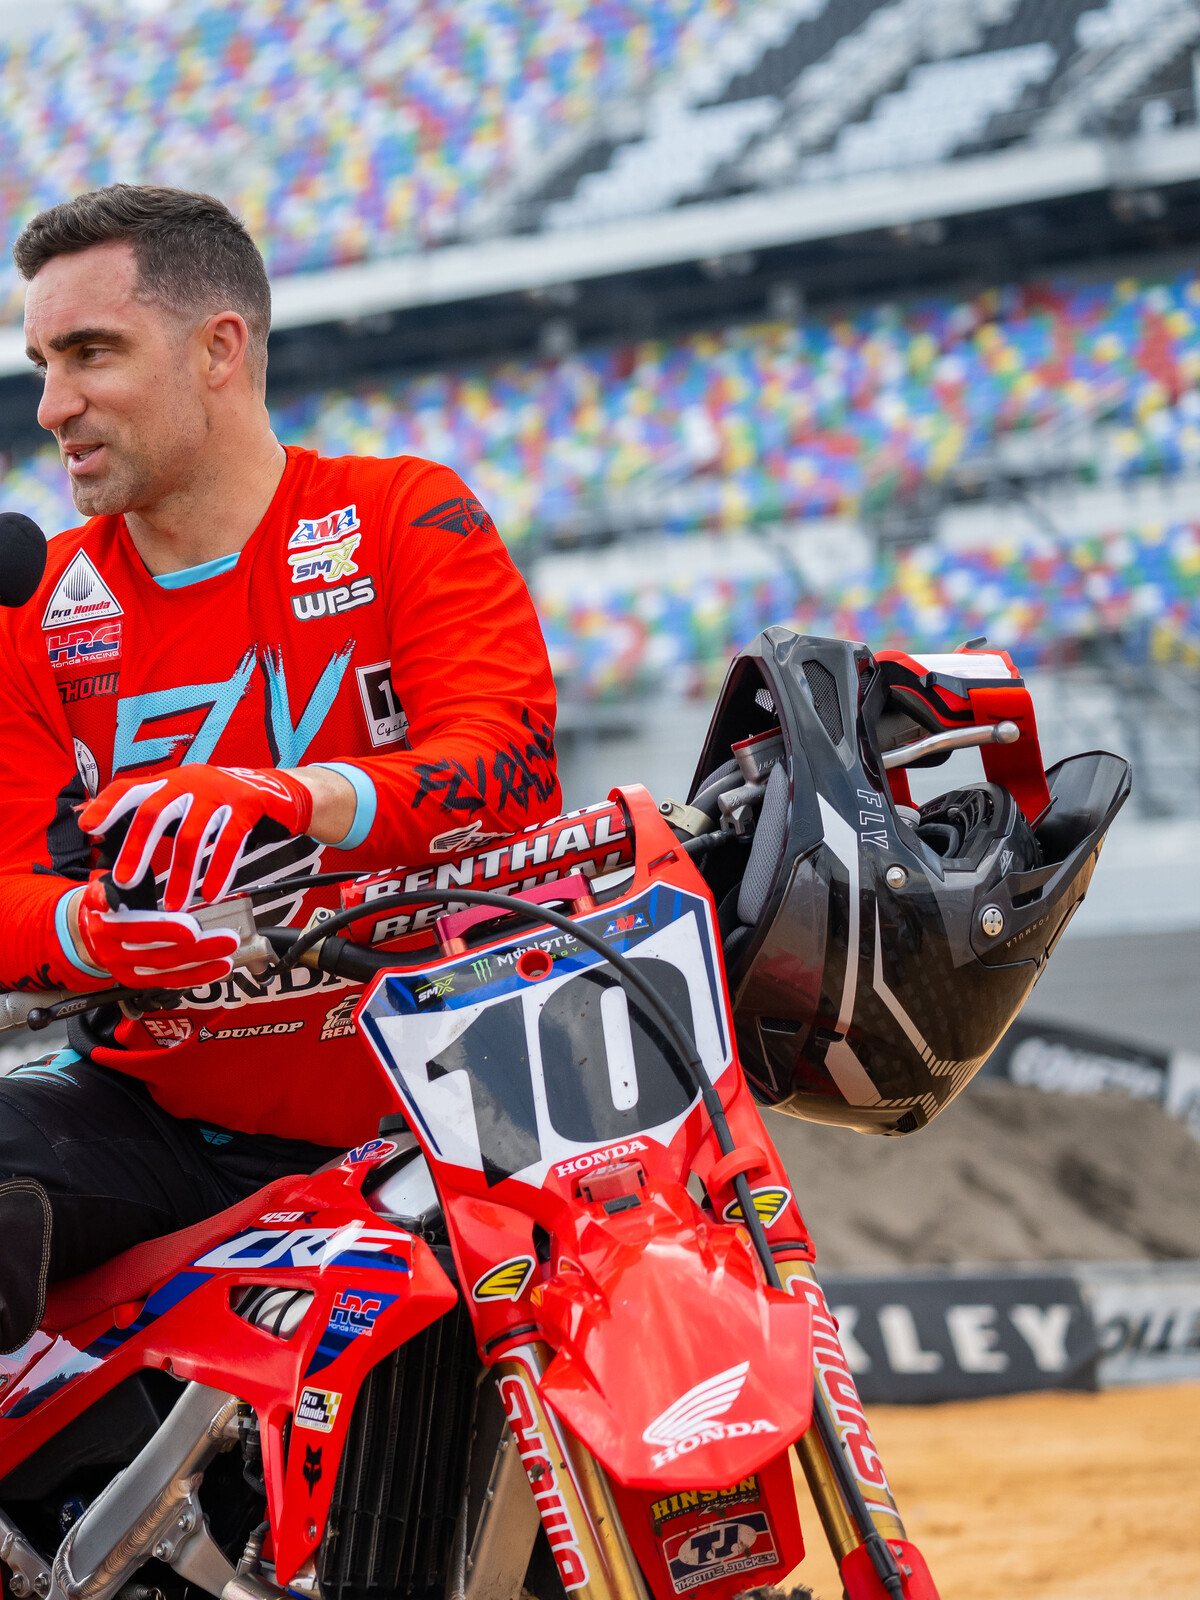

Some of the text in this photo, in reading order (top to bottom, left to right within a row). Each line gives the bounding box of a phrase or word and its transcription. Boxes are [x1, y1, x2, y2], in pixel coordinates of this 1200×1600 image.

[291, 508, 356, 543] AMA
[296, 543, 356, 579] SMX
[51, 601, 111, 620] Pro Honda
[291, 576, 376, 620] WPS
[48, 623, 121, 663] HRC
[82, 651, 119, 662] RACING
[856, 788, 889, 850] FLY
[363, 814, 628, 904] RENTHAL
[603, 912, 648, 938] AMA
[1006, 915, 1049, 948] FORMULA
[497, 932, 577, 967] MONSTE
[418, 975, 456, 1003] SMX
[214, 1022, 303, 1040] DUNLOP
[426, 957, 700, 1188] 10
[349, 1140, 383, 1163] VP
[555, 1140, 648, 1178] HONDA
[260, 1211, 319, 1224] 450R
[194, 1228, 412, 1268] CRF
[329, 1292, 381, 1329] HRC
[328, 1322, 373, 1336] Honda RACING
[299, 1403, 325, 1421] Honda
[302, 1392, 318, 1406] Pro
[650, 1419, 779, 1470] HONDA
[675, 1552, 778, 1592] THROTTLE JOCKEY
